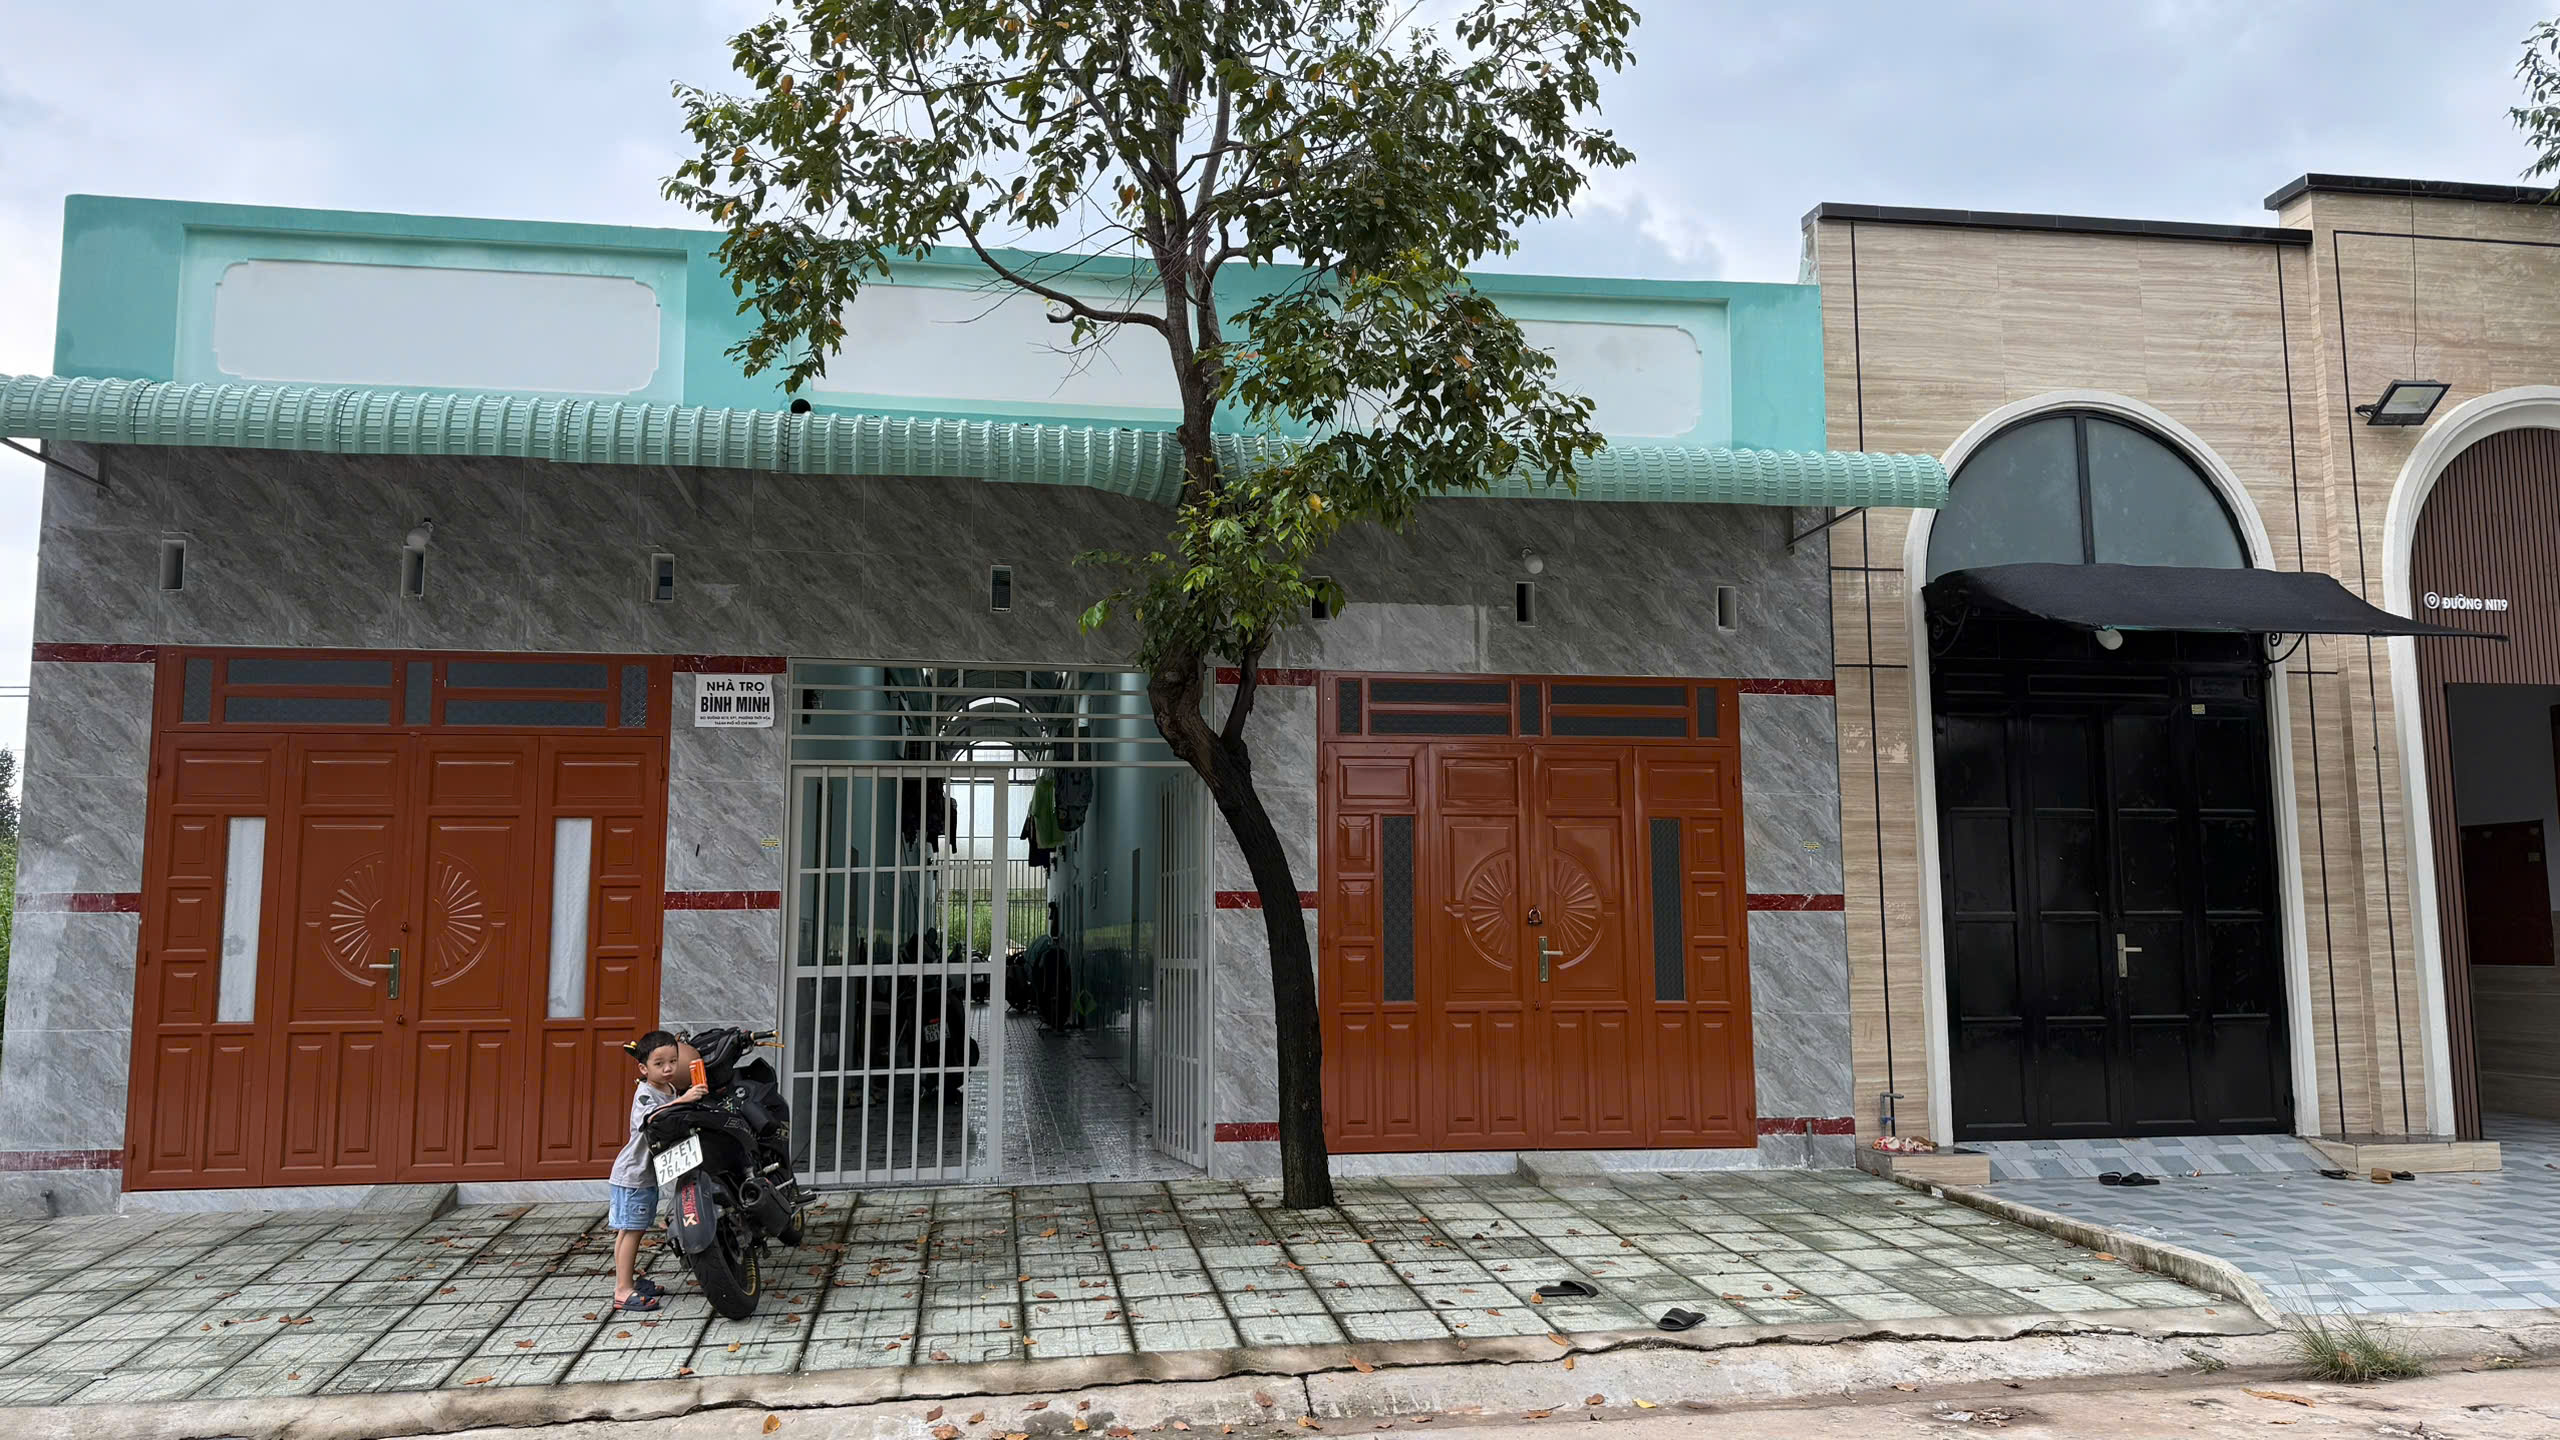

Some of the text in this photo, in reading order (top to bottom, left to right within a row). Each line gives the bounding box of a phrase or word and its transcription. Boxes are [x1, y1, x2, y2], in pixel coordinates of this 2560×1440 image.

[2441, 593, 2483, 610] ĐƯỜNG
[706, 678, 765, 695] NHÀ TRỌ
[700, 692, 770, 712] BÌNH MINH
[660, 1140, 692, 1167] 37-E1
